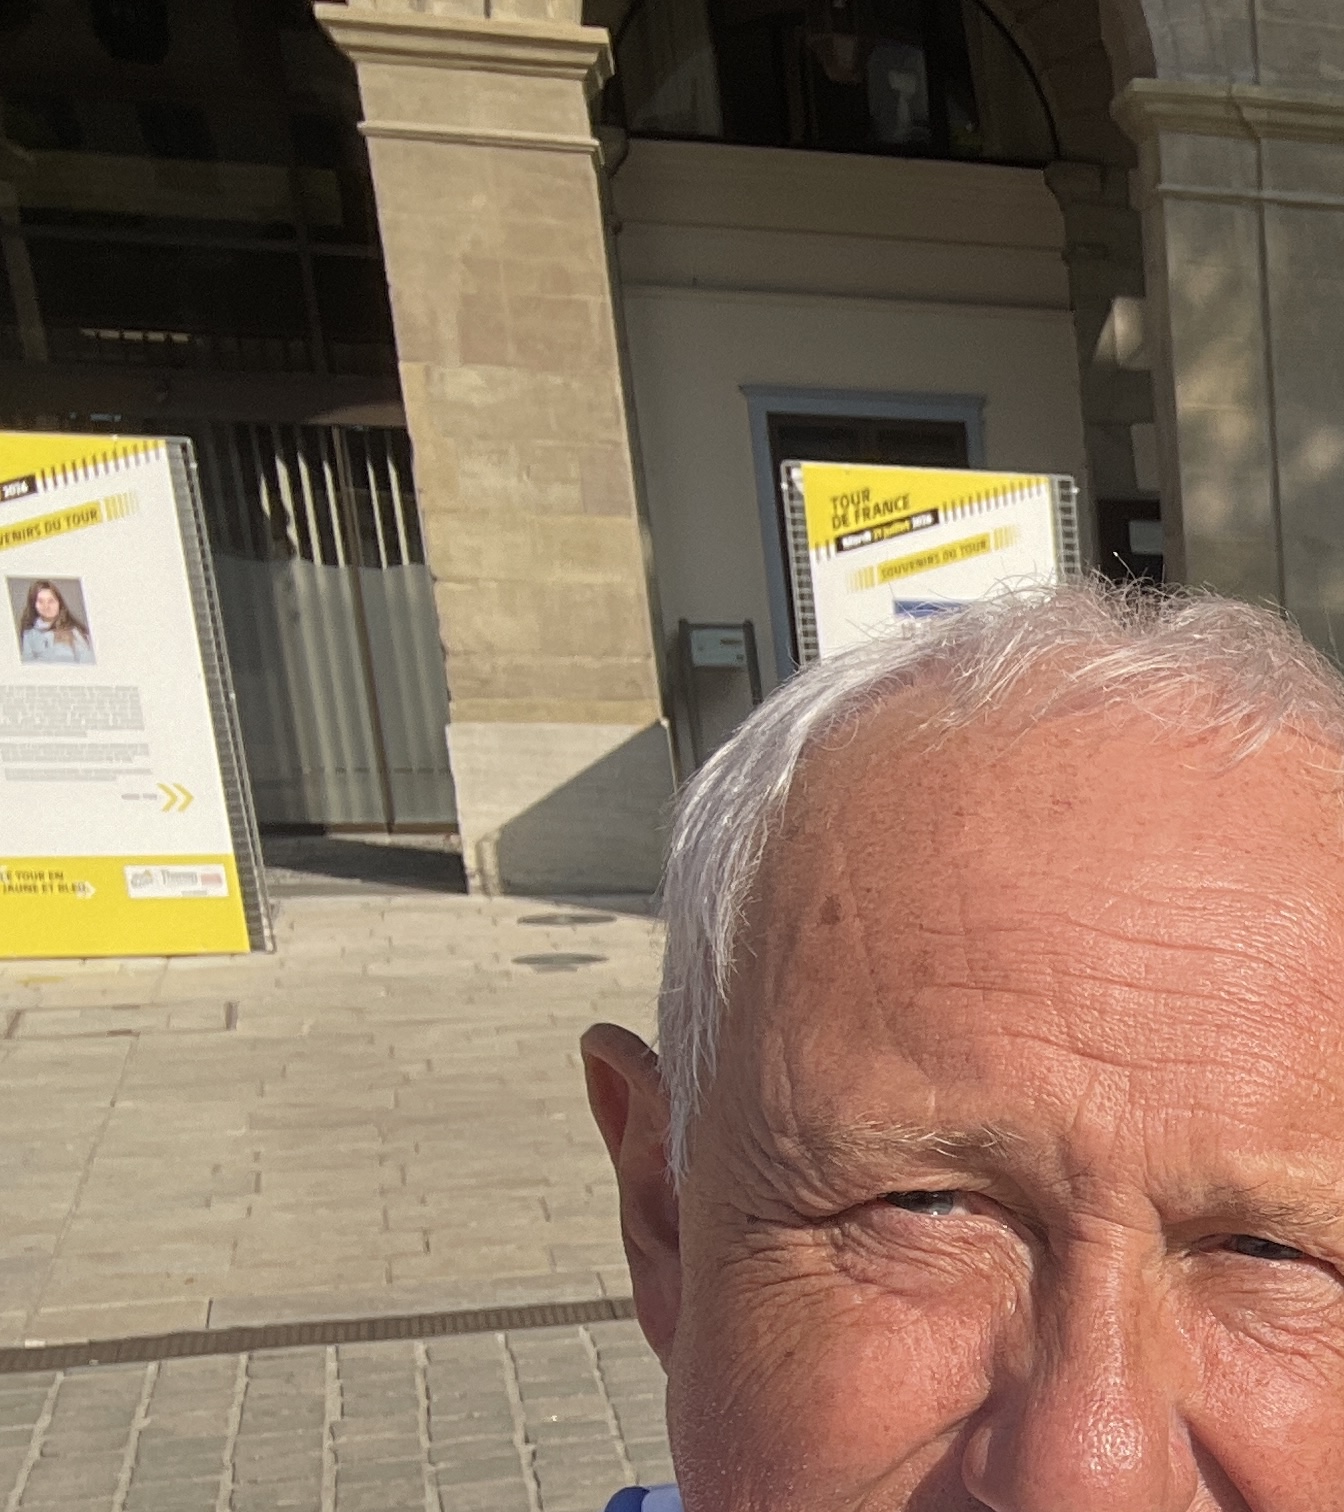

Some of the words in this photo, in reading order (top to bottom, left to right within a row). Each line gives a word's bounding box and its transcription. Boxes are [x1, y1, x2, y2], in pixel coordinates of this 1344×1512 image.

[830, 487, 870, 511] TOUR
[832, 513, 850, 530] DE
[855, 493, 911, 524] FRANCE
[44, 521, 61, 534] DU
[64, 507, 98, 529] TOUR
